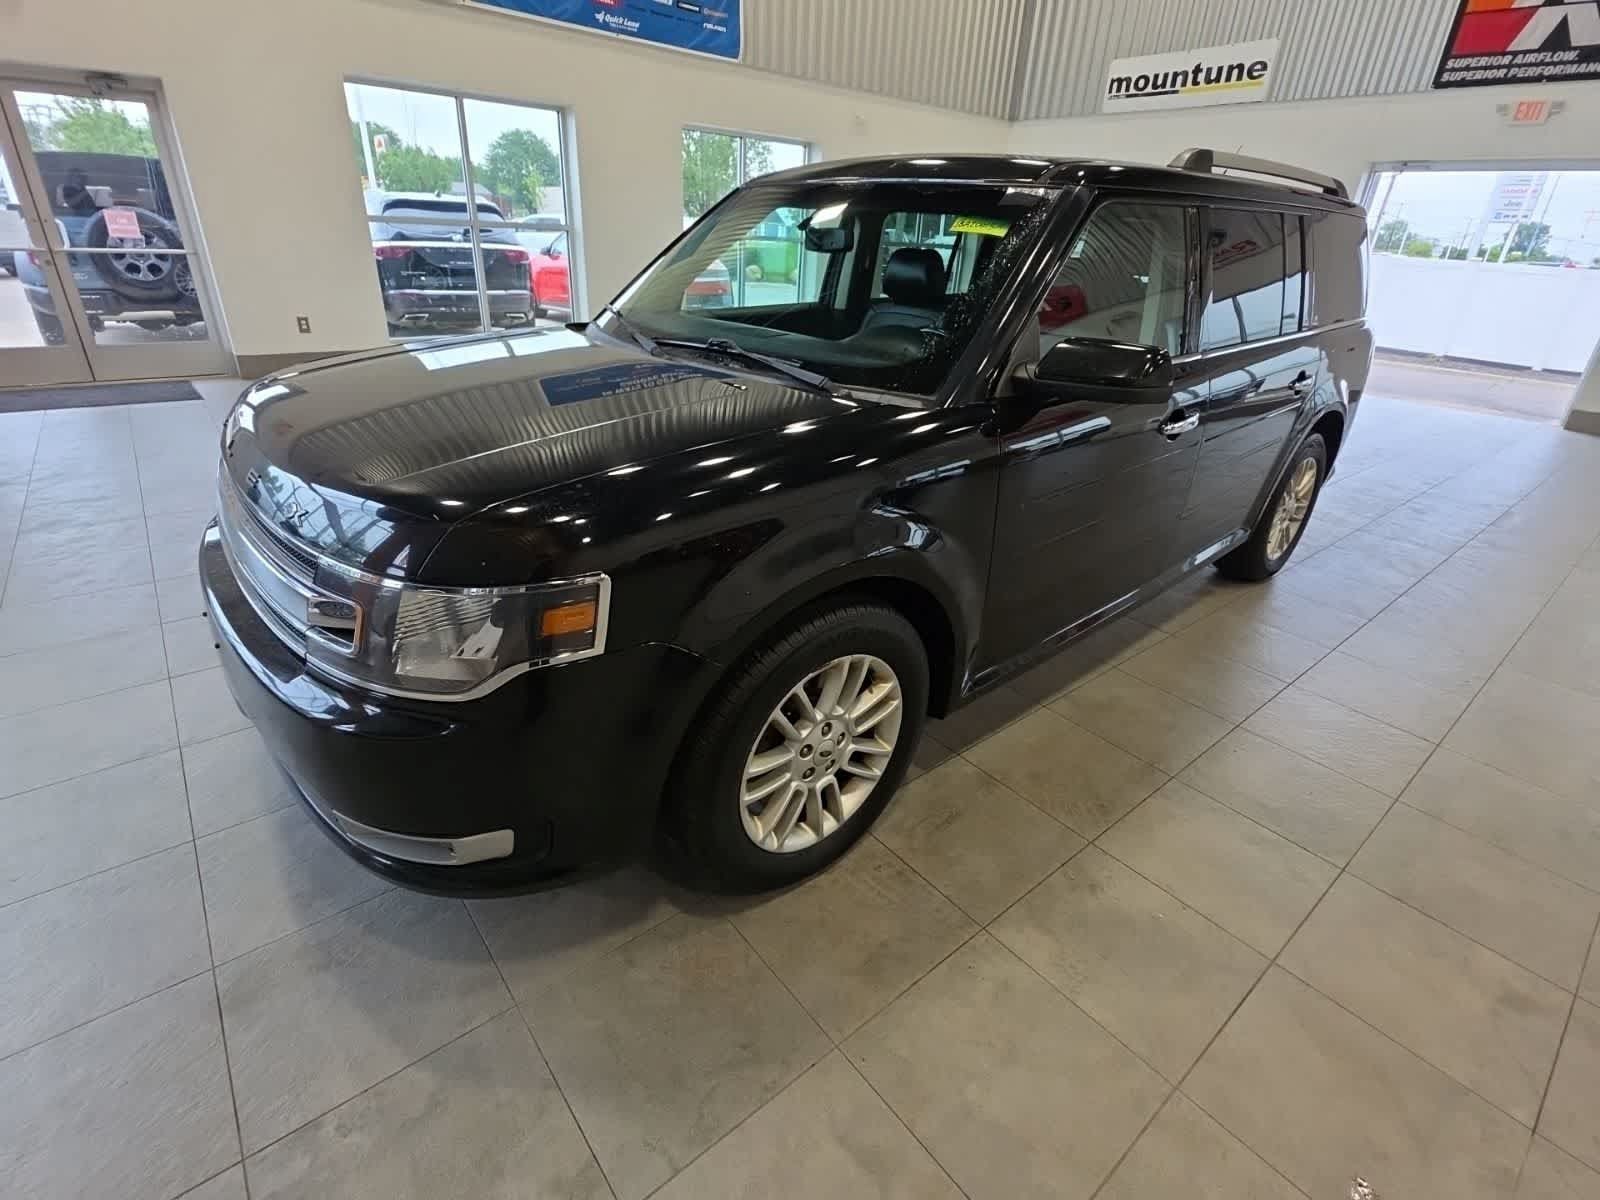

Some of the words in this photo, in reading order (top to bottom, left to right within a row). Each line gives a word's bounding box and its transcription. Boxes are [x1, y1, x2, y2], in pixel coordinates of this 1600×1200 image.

[604, 14, 623, 25] Quick
[624, 18, 641, 28] Lane
[1446, 54, 1509, 69] SUPERIOR
[1512, 50, 1579, 66] AIRFLOW.
[1108, 60, 1268, 94] mountune
[1440, 67, 1505, 82] SUPERIOR
[1513, 101, 1545, 121] EXIT
